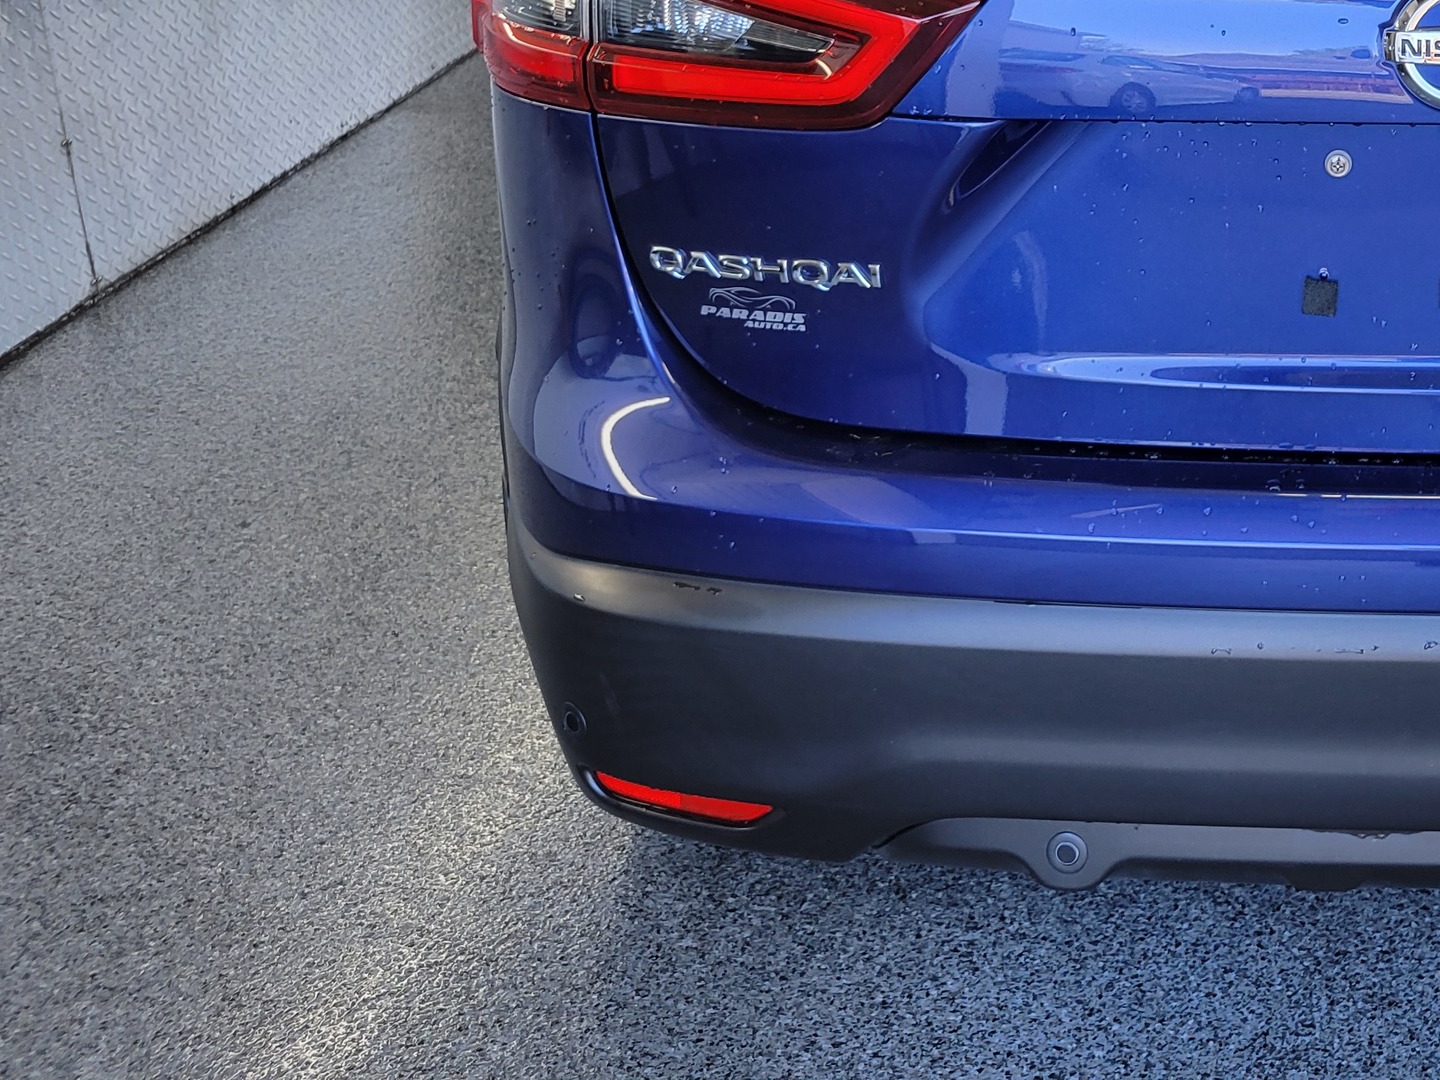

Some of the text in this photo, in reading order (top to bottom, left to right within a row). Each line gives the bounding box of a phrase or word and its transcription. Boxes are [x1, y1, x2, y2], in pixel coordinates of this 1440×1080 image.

[650, 245, 882, 292] QASHQAI
[700, 304, 807, 324] PARADIS
[744, 320, 807, 332] AUTO.CA
